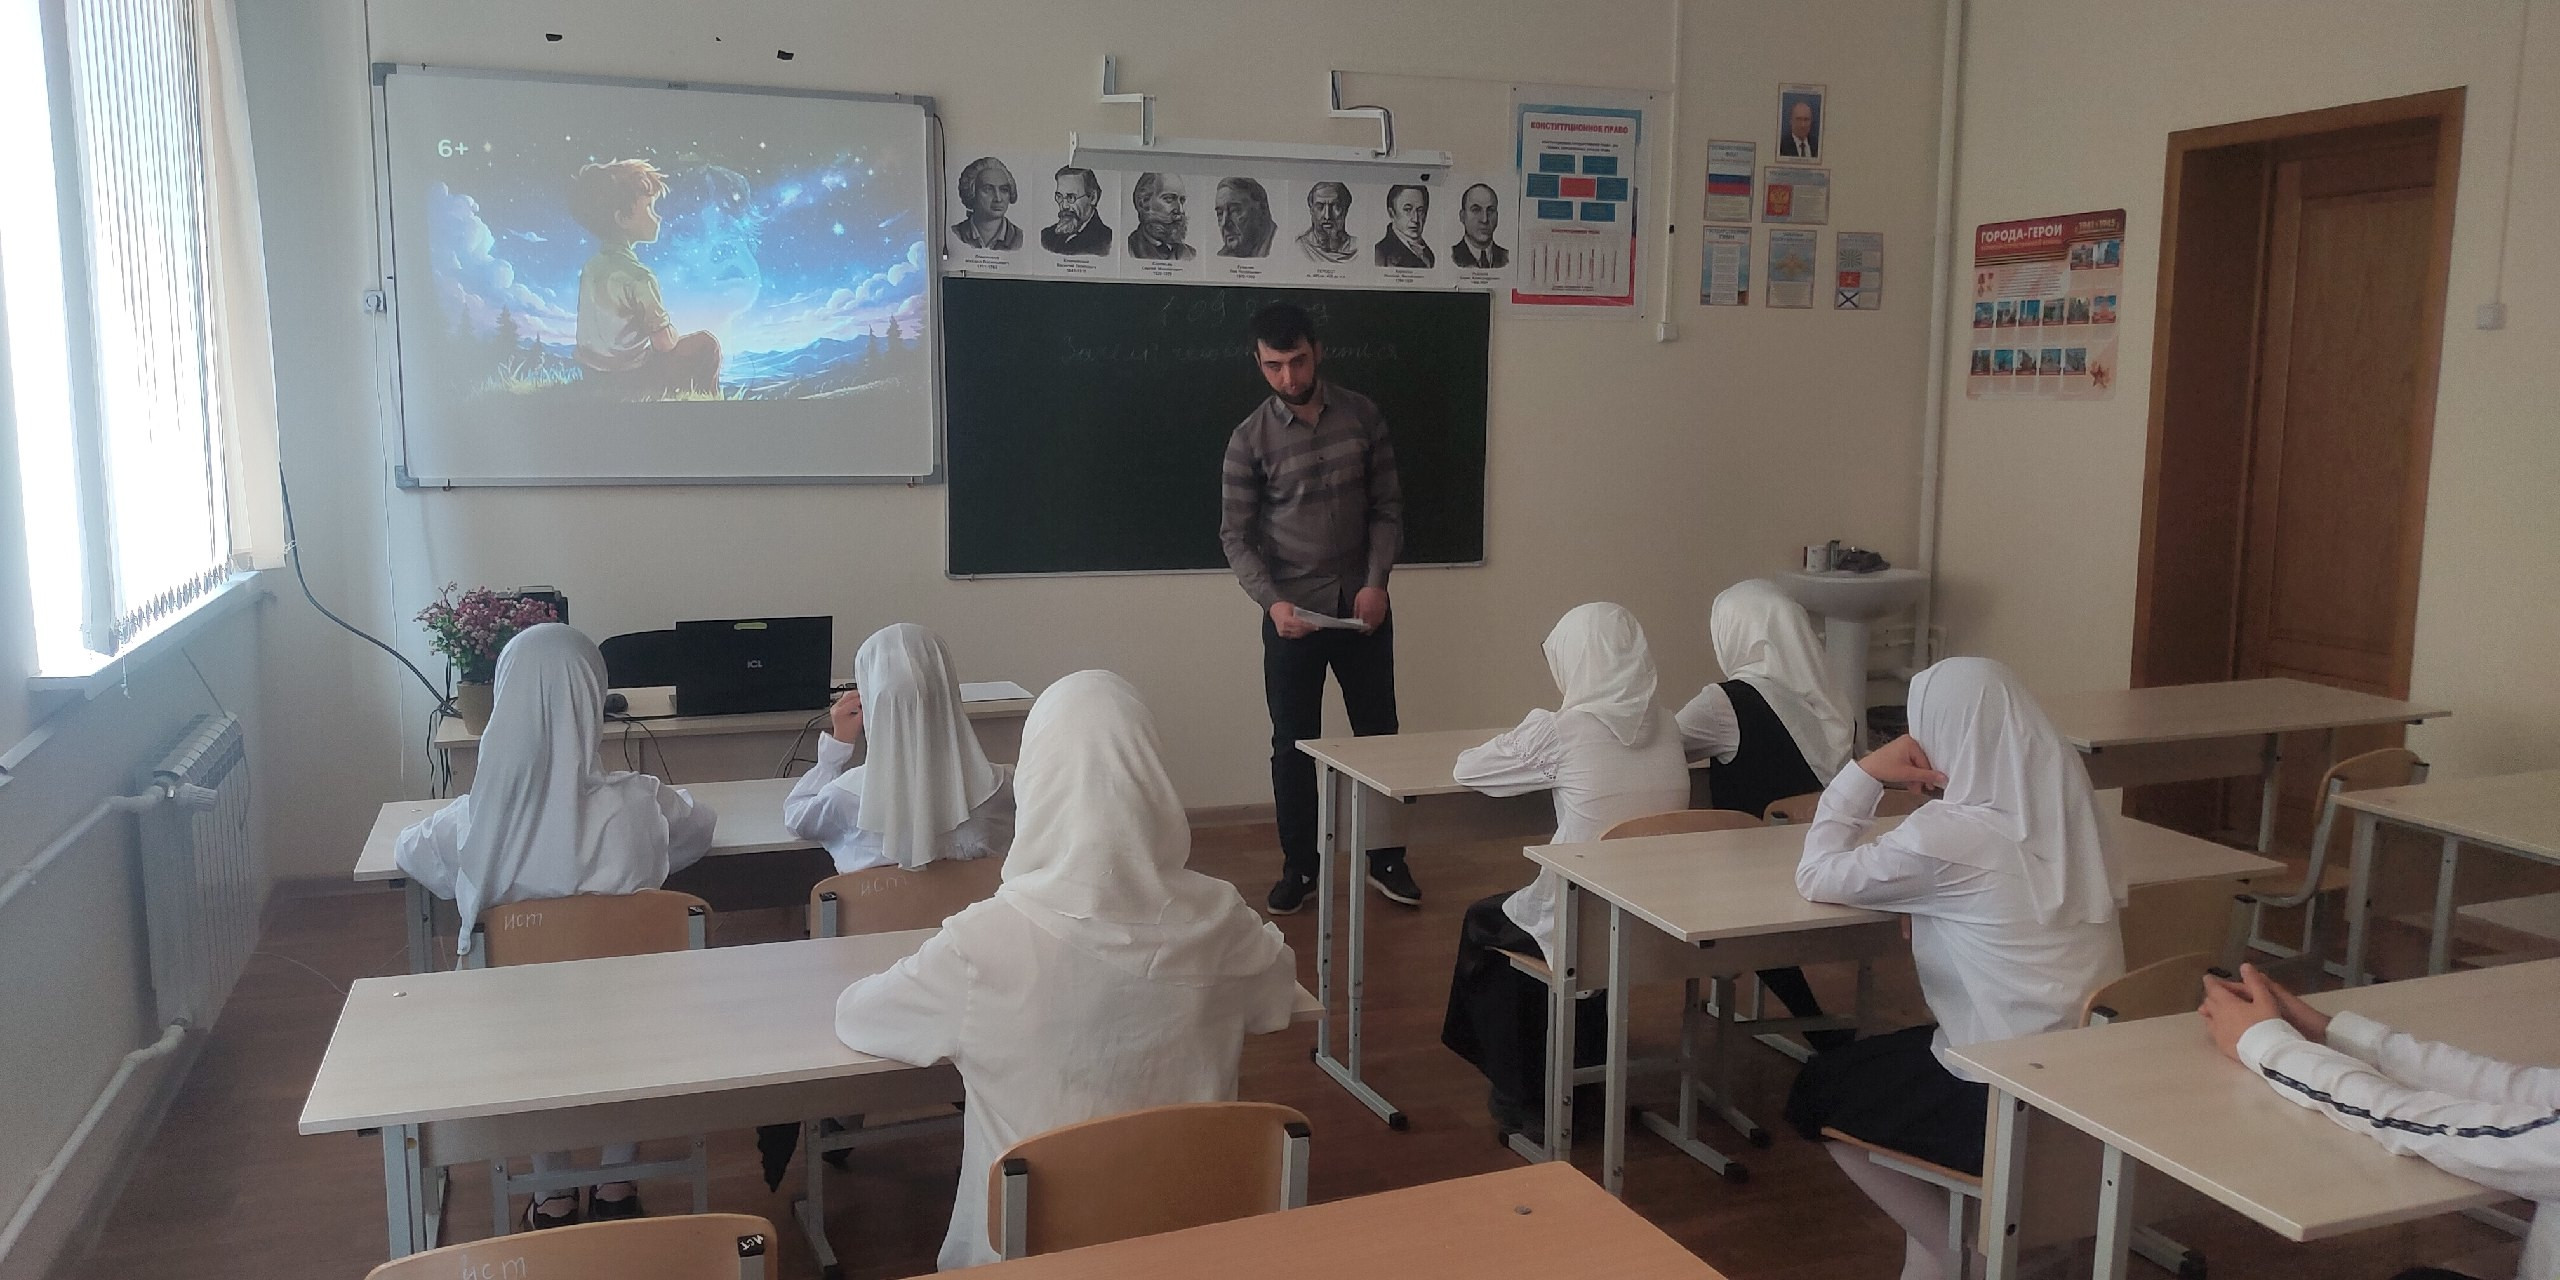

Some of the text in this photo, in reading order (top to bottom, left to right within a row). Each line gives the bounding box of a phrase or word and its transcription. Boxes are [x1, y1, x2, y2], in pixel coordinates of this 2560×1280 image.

[1530, 121, 1629, 134] КОНСТИТУЦИОННОЕ ПРАВО
[438, 139, 469, 158] 6+
[1981, 223, 2063, 244] ГОРОДА-ГЕРОИ
[747, 659, 763, 669] ICL
